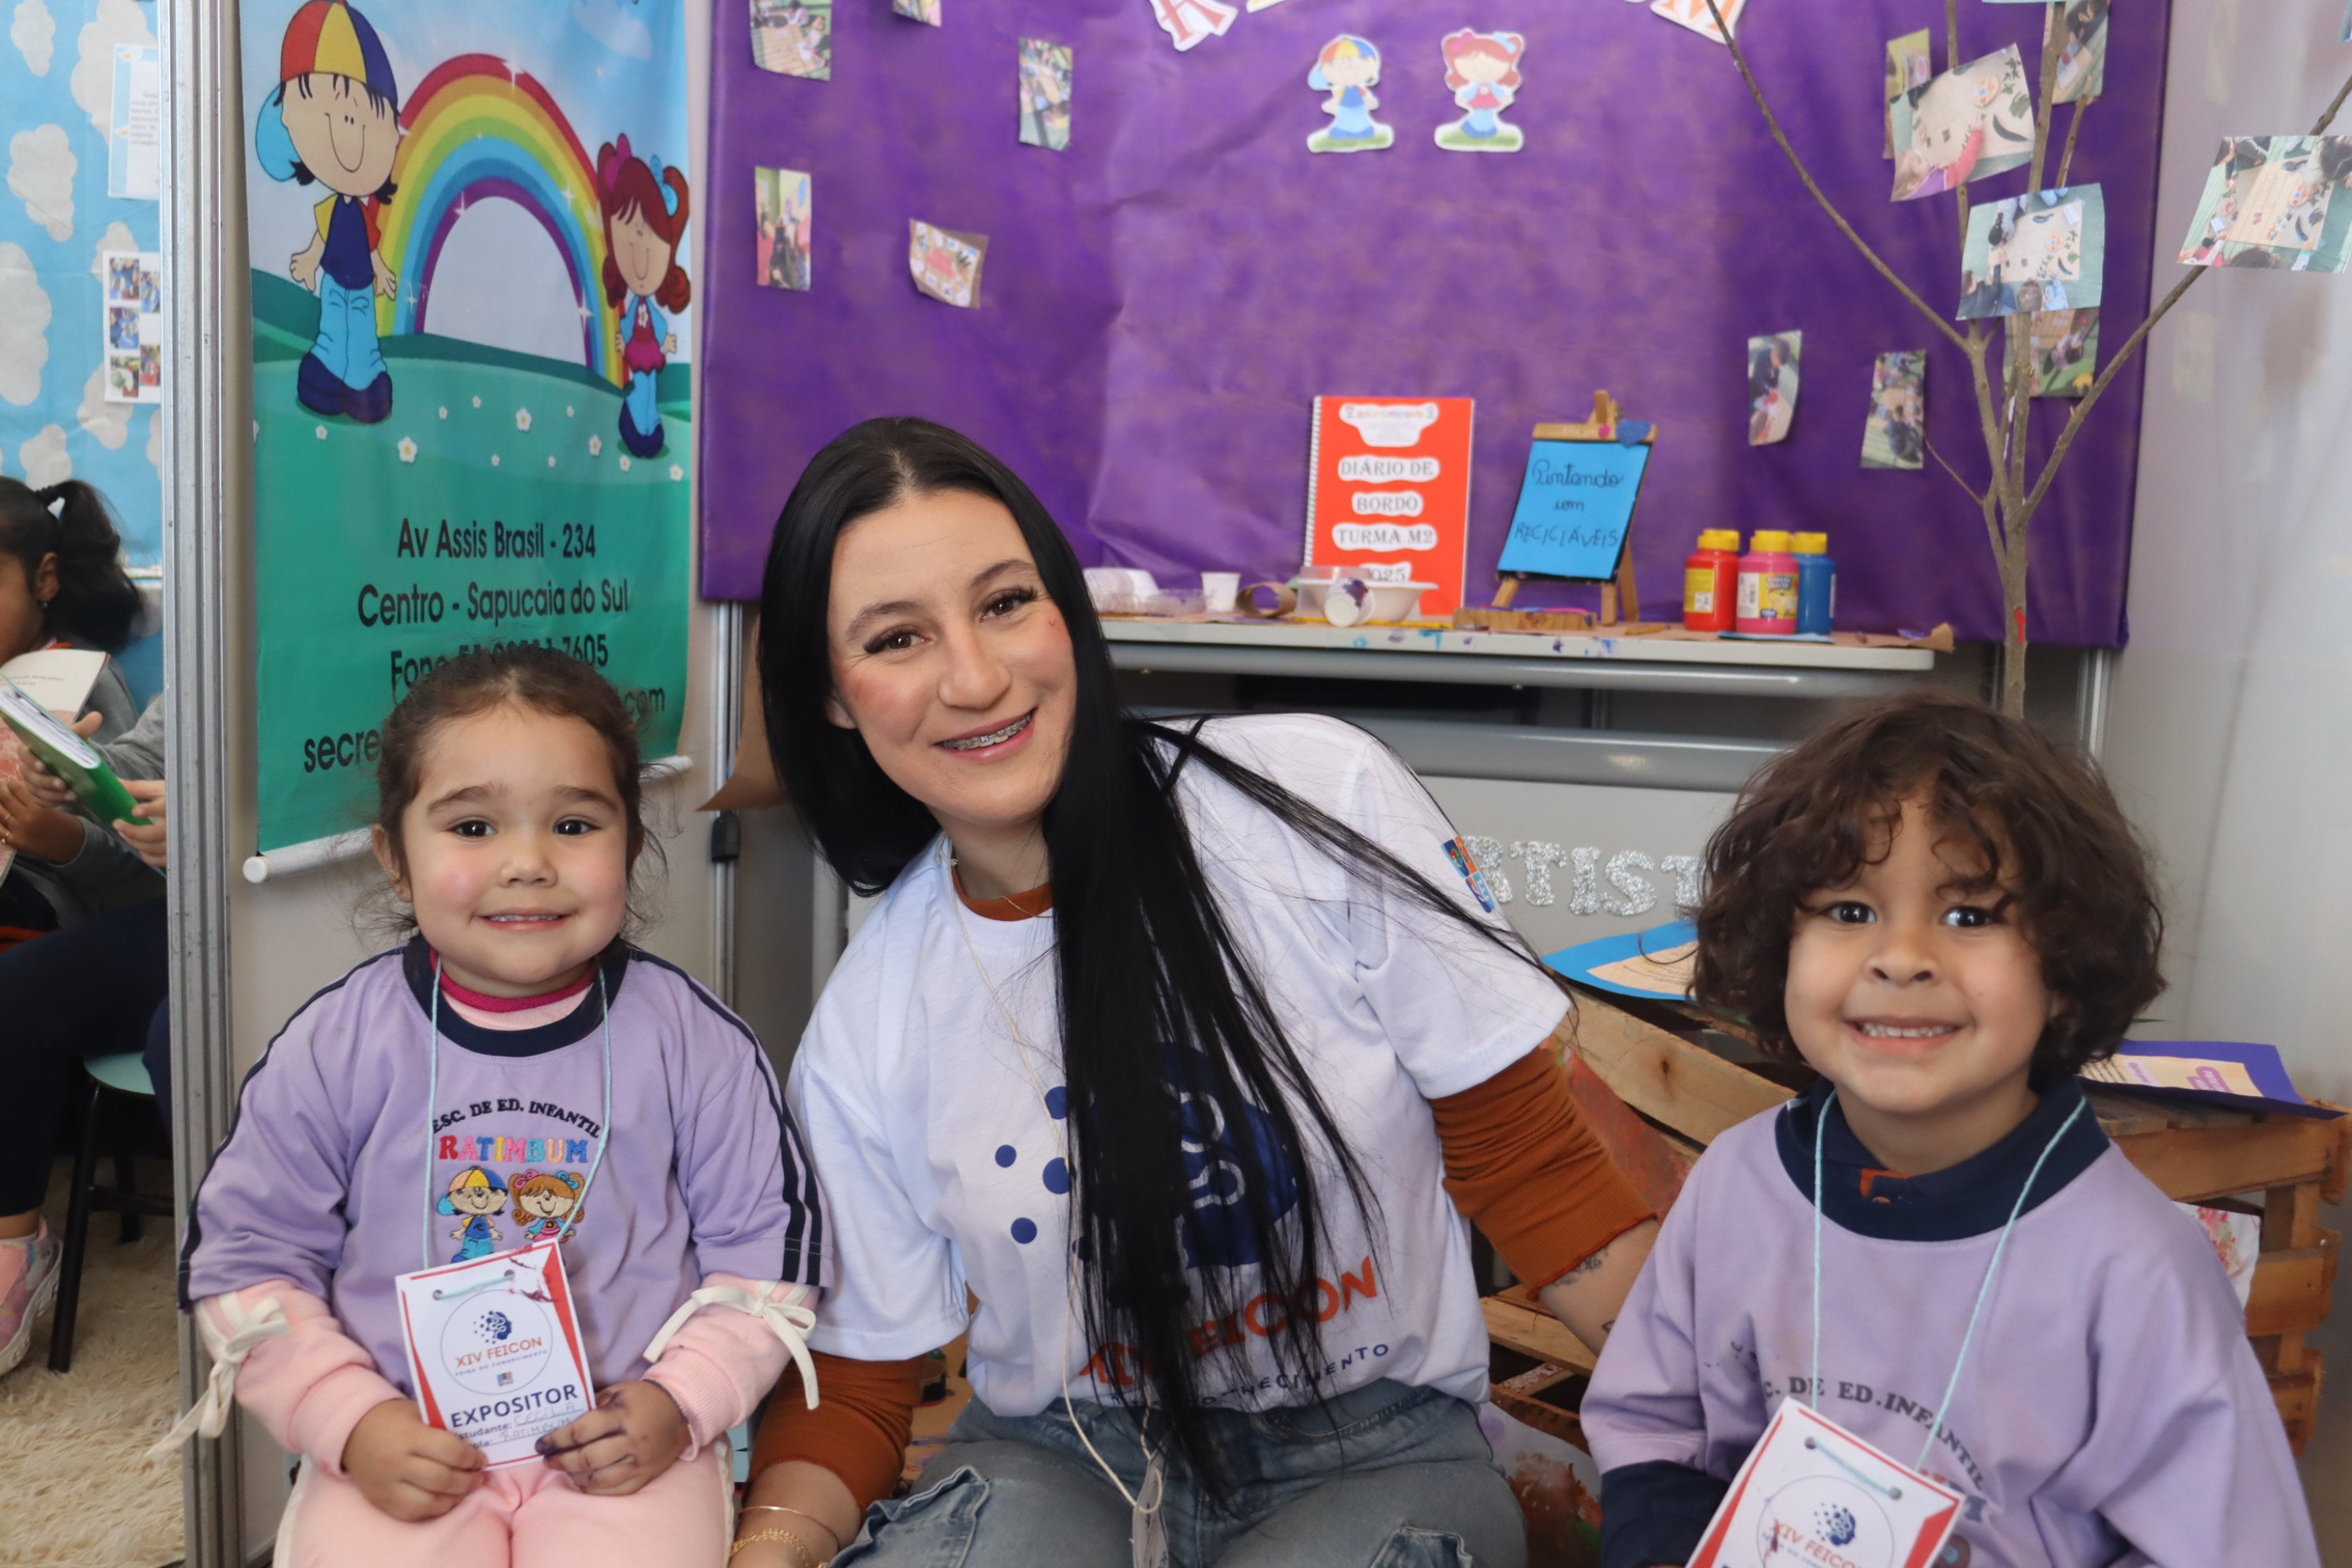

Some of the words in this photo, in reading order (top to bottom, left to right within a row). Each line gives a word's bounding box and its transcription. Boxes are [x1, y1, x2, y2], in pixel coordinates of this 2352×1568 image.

[1340, 457, 1404, 477] DIÁRIO
[1409, 460, 1434, 477] DE
[1531, 458, 1624, 488] Pintando
[1356, 496, 1418, 512] BORDO
[1553, 500, 1585, 512] com
[397, 517, 429, 558] Av
[435, 519, 487, 559] Assis
[494, 520, 544, 558] Brasil
[562, 523, 596, 559] 234
[1337, 529, 1401, 544] TURMA
[1407, 529, 1434, 544] M2
[1371, 567, 1406, 583] 025
[357, 583, 444, 627] Centro
[467, 580, 565, 627] Sapucaia
[570, 579, 596, 615] do
[601, 577, 630, 613] Sul
[470, 1099, 493, 1118] DE
[497, 1098, 524, 1112] ED.
[528, 1100, 602, 1139] INFANTIL
[439, 1134, 589, 1164] RATIMBUM
[455, 1350, 483, 1368] XIV
[487, 1336, 543, 1360] FEICON
[1788, 1376, 1825, 1397] DE
[450, 1384, 579, 1428] EXPOSITOR
[456, 1423, 513, 1441] studante:
[1804, 1540, 1864, 1568] FEICO
